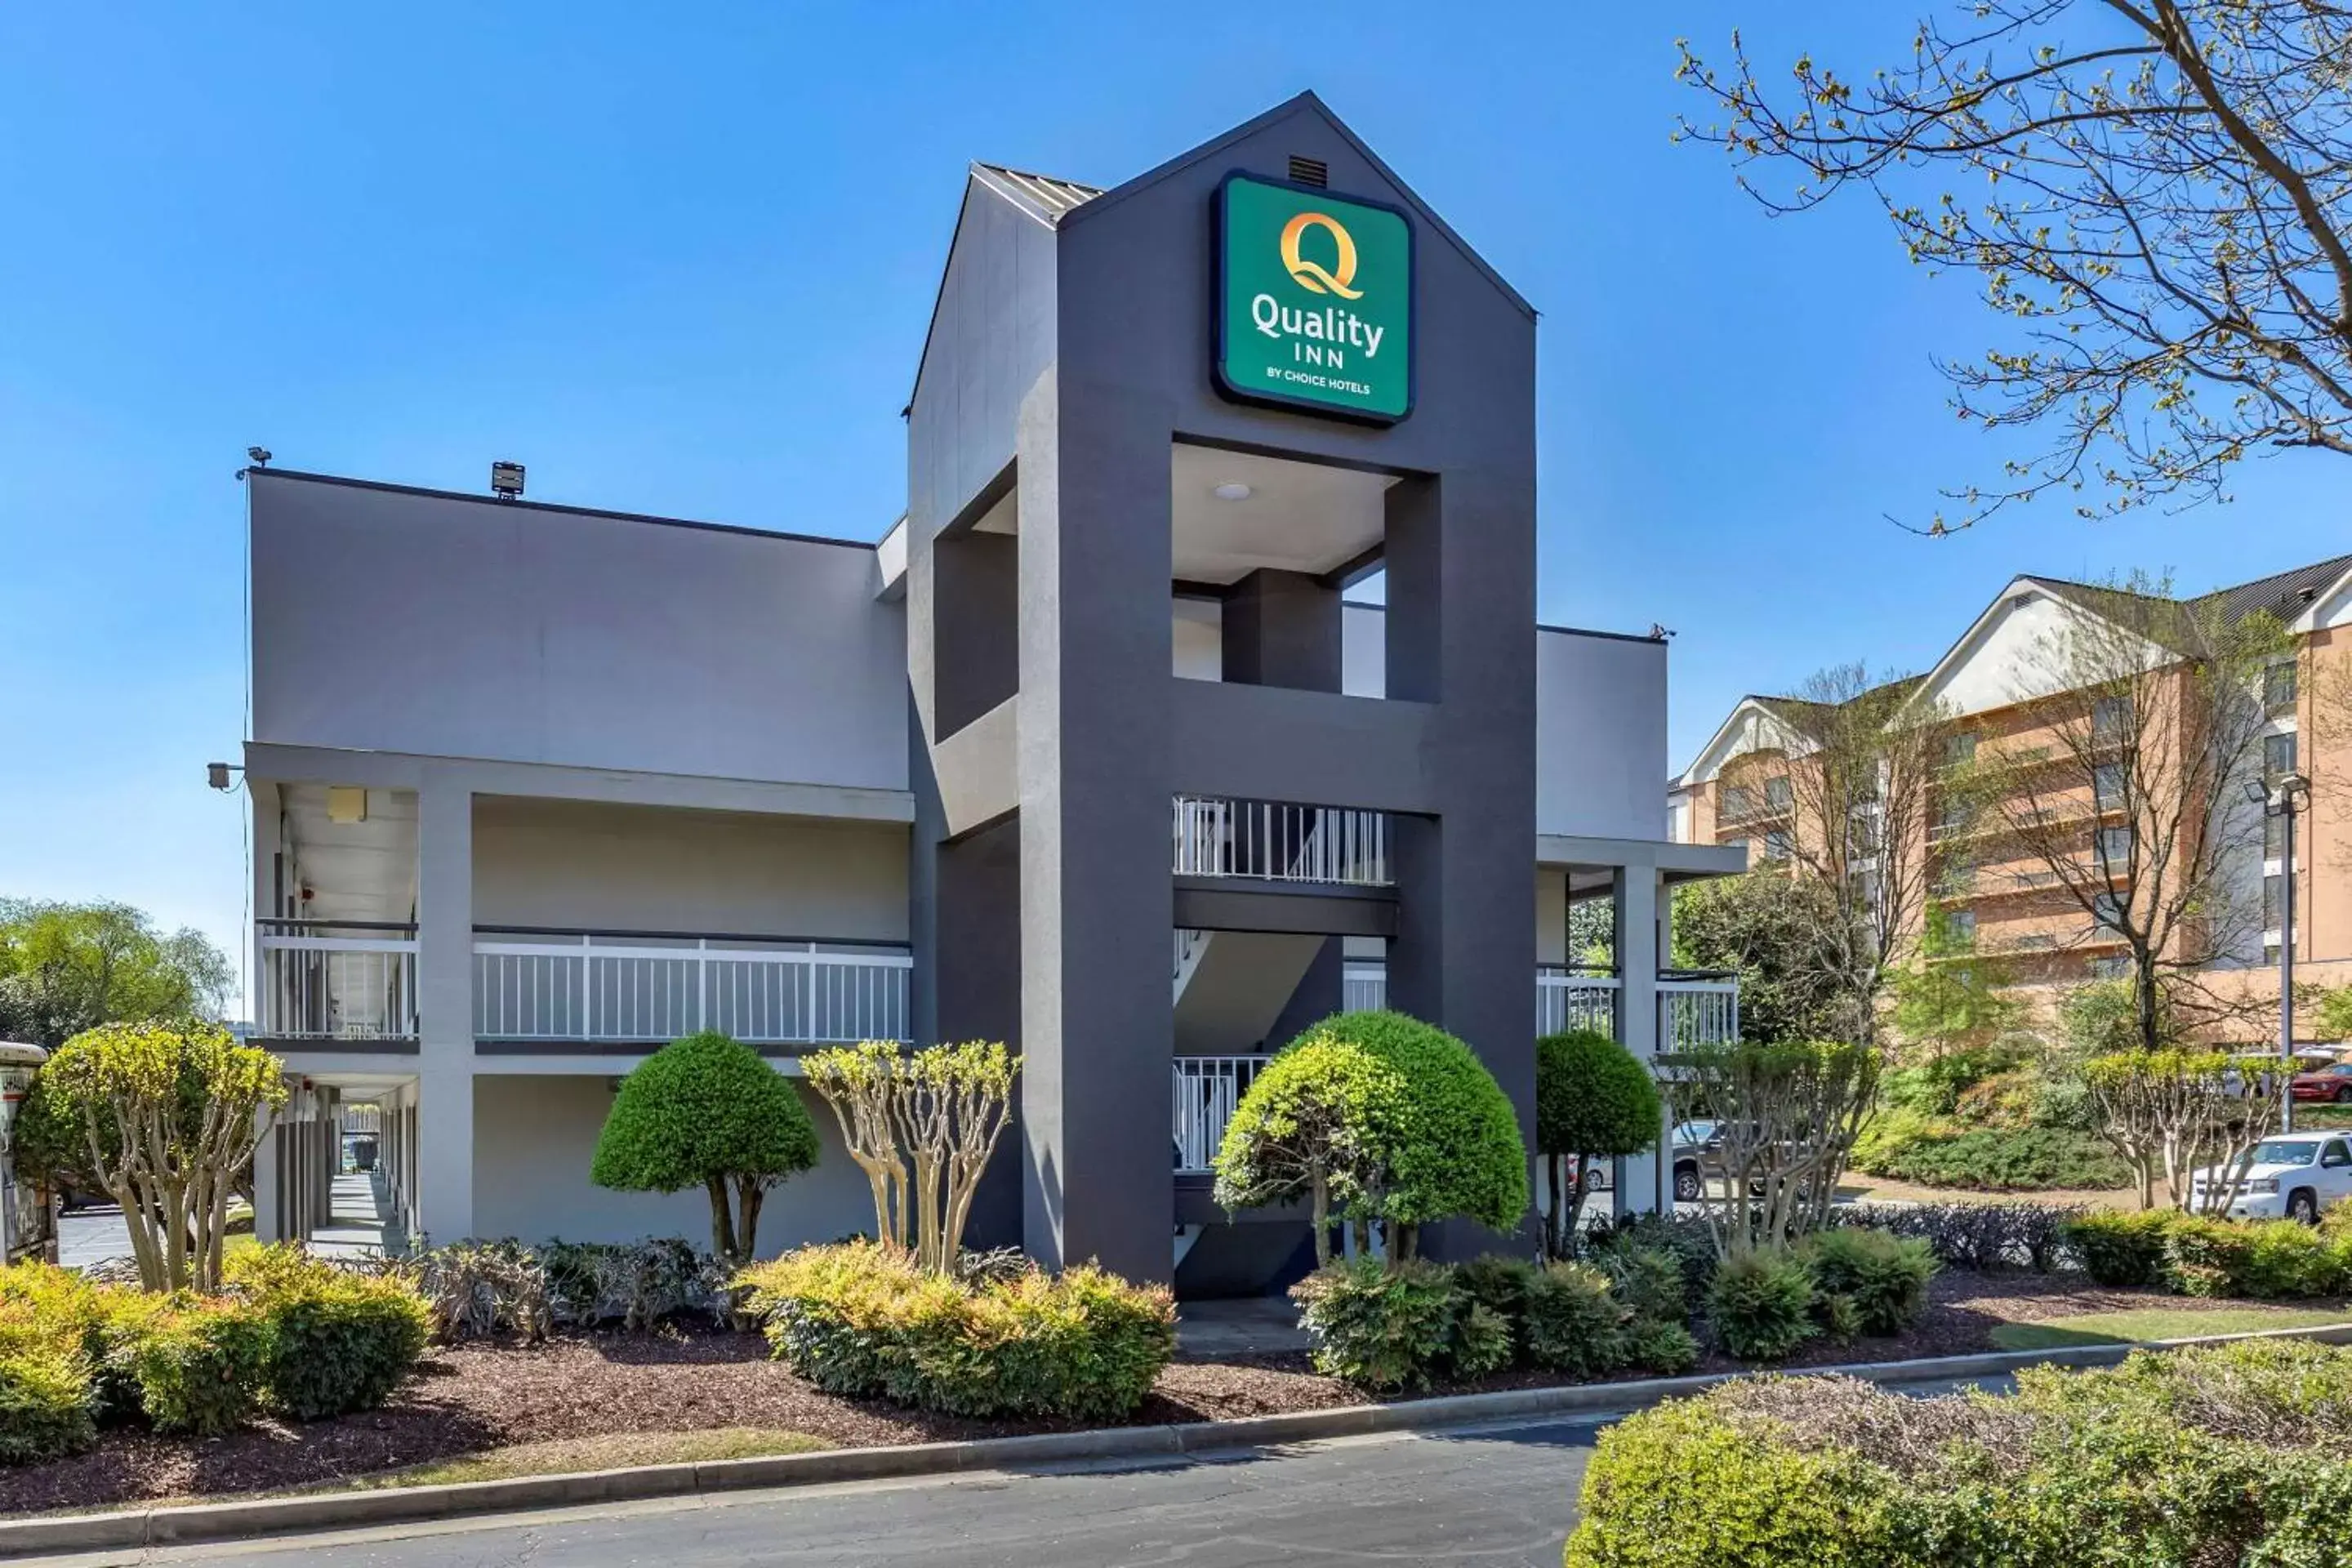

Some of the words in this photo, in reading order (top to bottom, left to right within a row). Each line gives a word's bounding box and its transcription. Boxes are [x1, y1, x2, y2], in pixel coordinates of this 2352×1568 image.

[1281, 212, 1364, 300] Q
[1252, 294, 1383, 358] Quality
[1294, 342, 1343, 369] INN
[1267, 367, 1281, 378] BY
[1285, 370, 1326, 388] CHOICE
[1329, 379, 1370, 394] HOTELS
